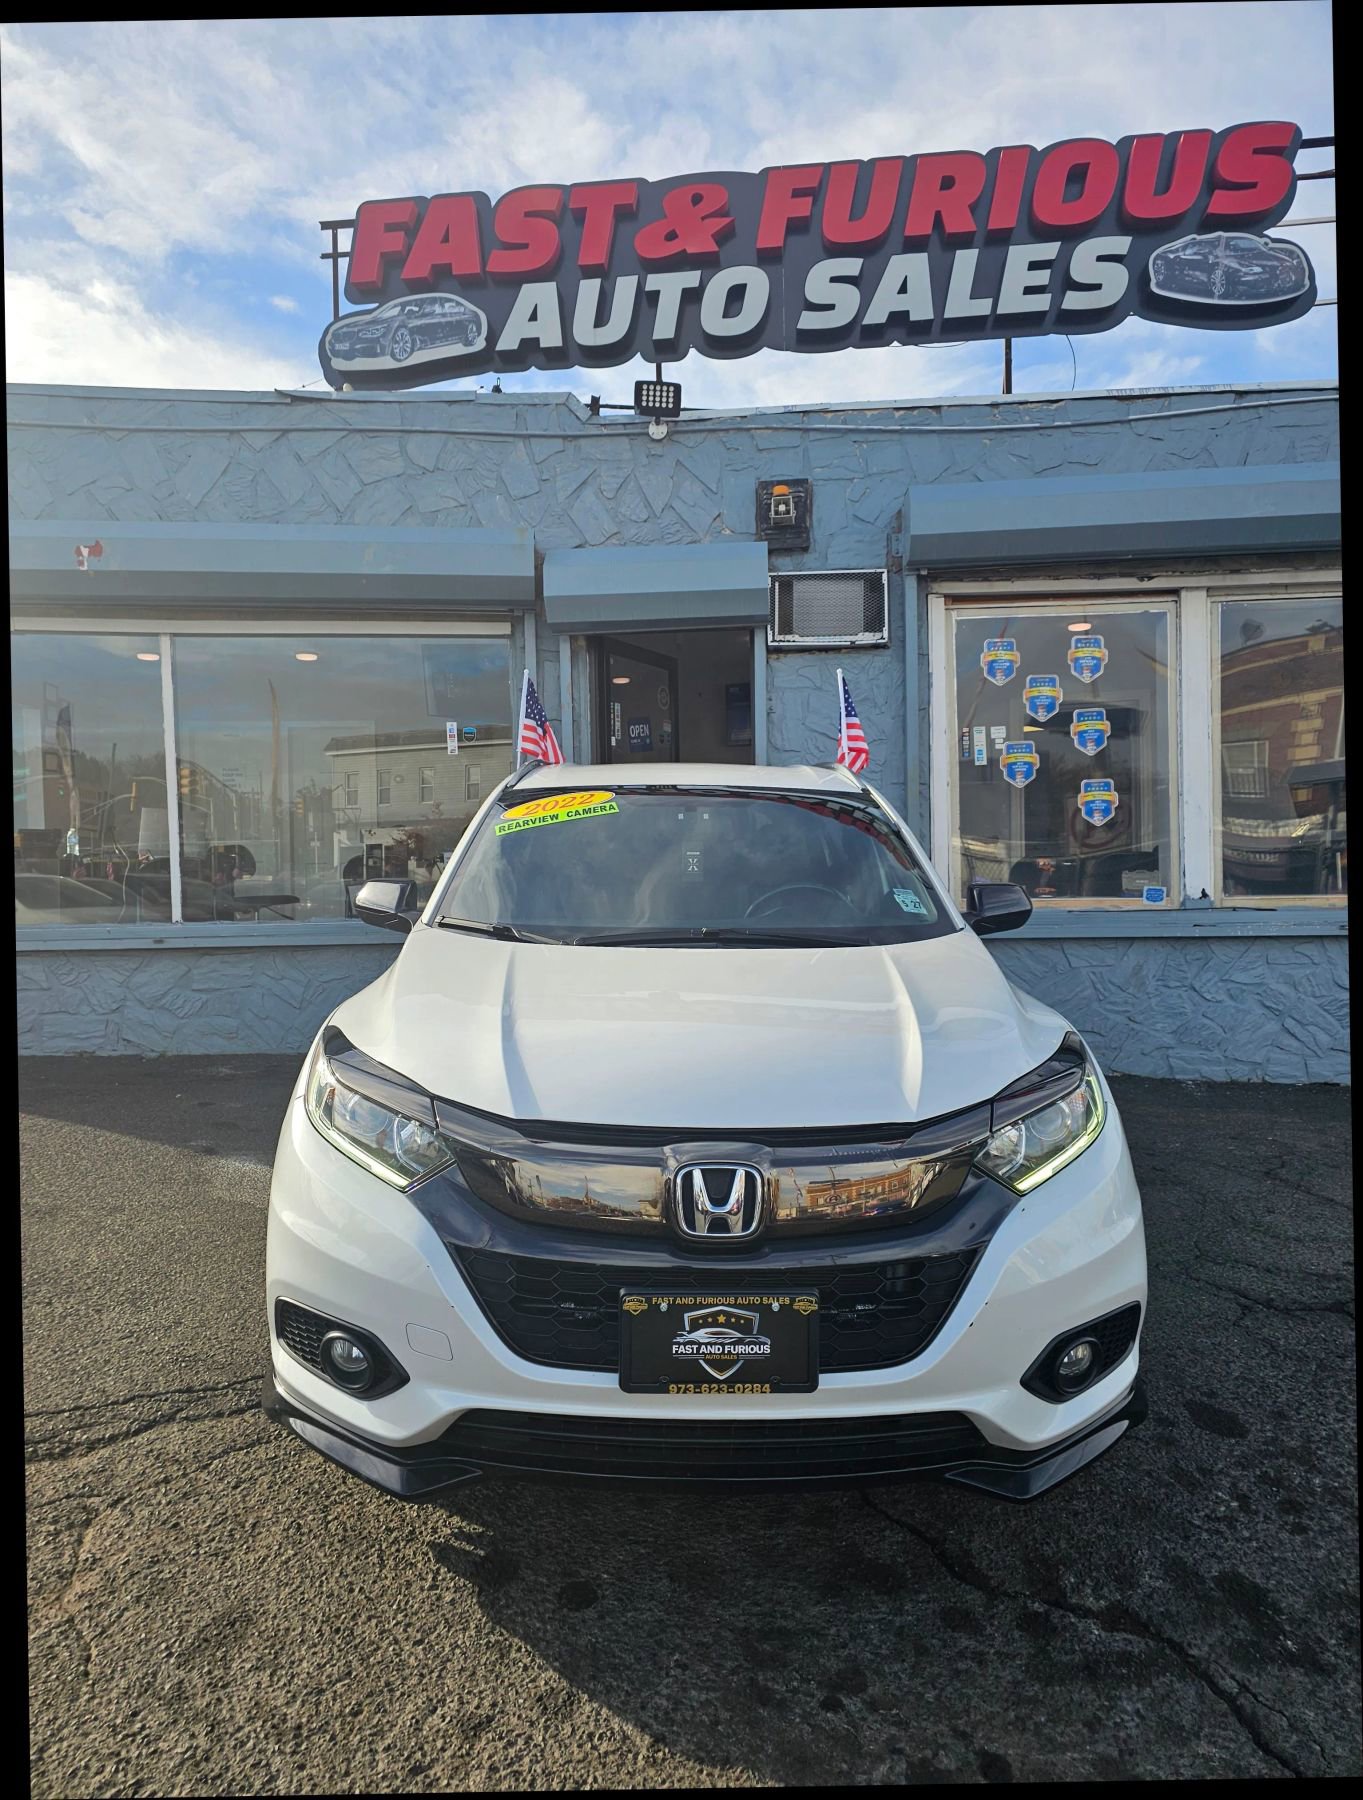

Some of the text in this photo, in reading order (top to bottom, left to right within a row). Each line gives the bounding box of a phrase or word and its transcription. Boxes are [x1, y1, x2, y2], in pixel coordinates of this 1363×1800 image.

[349, 121, 1298, 289] FAST & FURIOUS
[495, 236, 1133, 352] AUTO SALES
[629, 724, 649, 737] OPEN
[522, 793, 596, 817] 2022
[498, 804, 616, 833] REARVIEW CAMERA
[652, 1297, 790, 1305] FAST AND FURIOUS AUTO SALES
[672, 1345, 770, 1353] FAST AND FURIOUS
[668, 1384, 771, 1394] 973-623-0284
